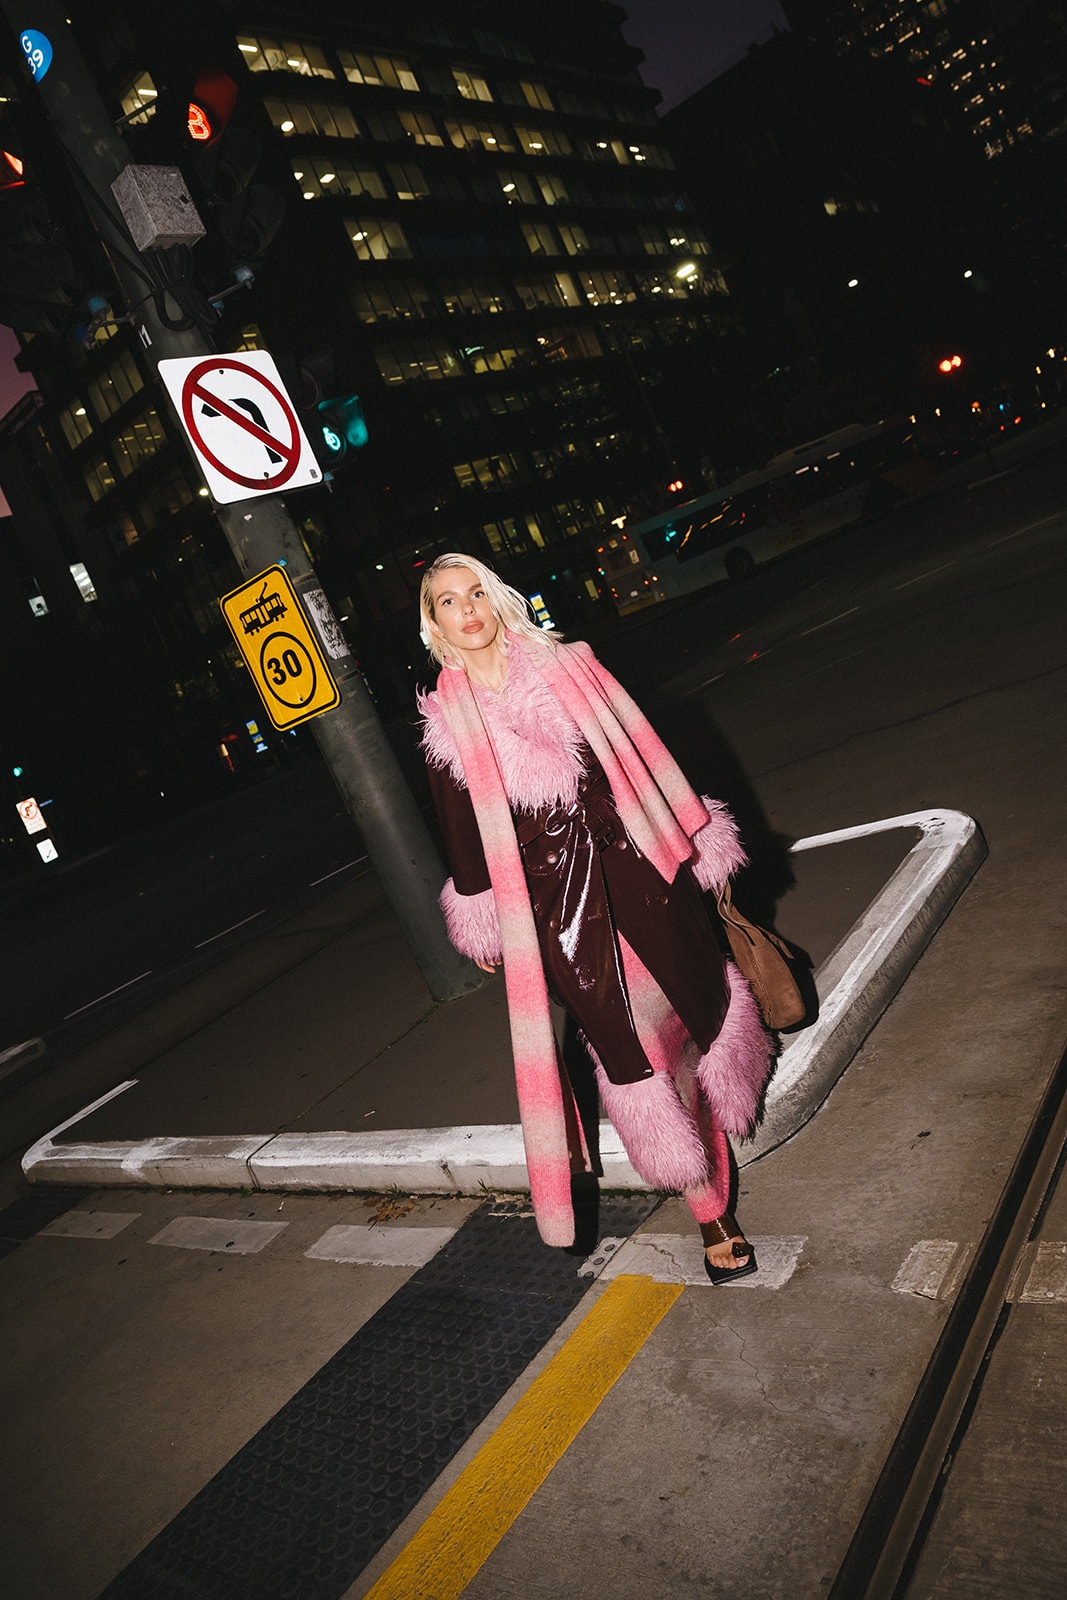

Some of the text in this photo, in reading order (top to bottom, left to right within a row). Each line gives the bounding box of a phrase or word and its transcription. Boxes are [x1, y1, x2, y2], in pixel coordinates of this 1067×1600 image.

[22, 35, 32, 53] G
[28, 49, 43, 75] 39
[267, 649, 302, 685] 30
